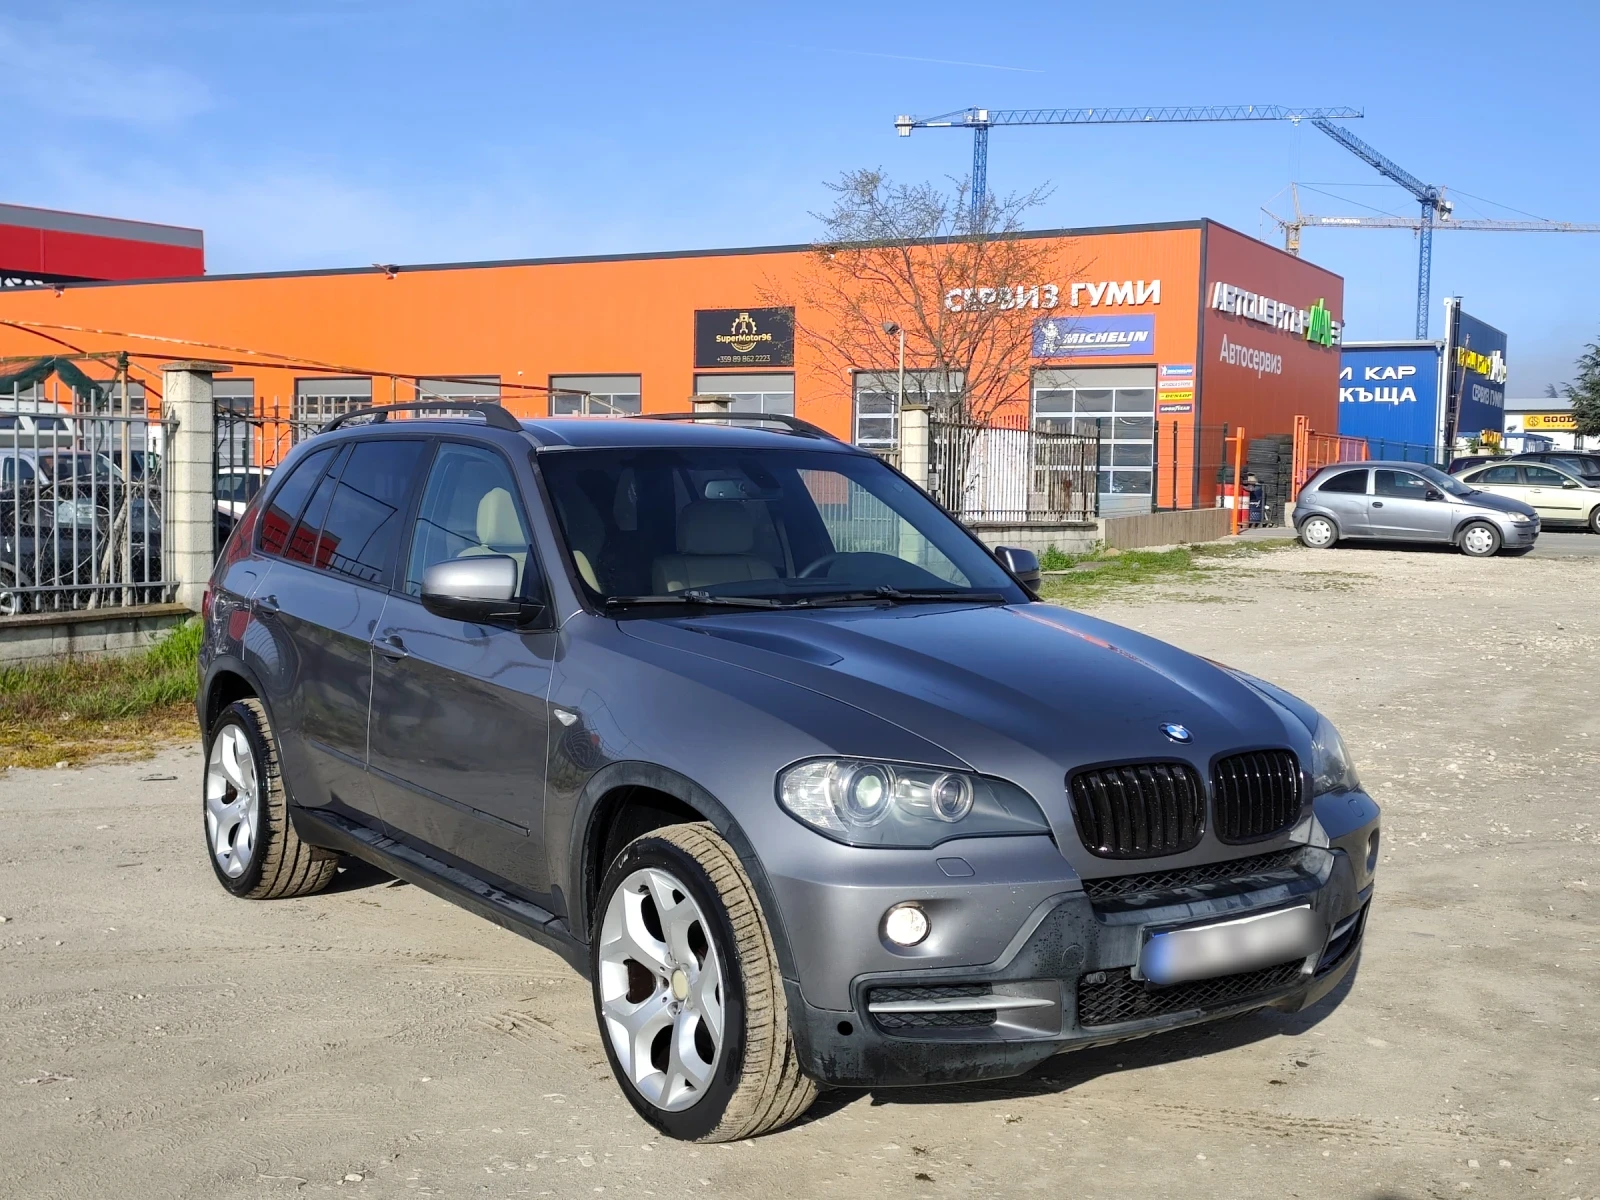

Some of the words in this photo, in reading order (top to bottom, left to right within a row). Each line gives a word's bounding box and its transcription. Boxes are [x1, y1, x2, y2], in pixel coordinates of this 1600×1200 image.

[1070, 280, 1161, 307] ГУМИ
[716, 333, 772, 344] SuperMotor96
[1063, 331, 1149, 344] MICHELIN
[717, 355, 731, 363] +359
[732, 355, 741, 363] 89
[742, 355, 754, 363] 862
[755, 354, 771, 362] 2223
[1365, 366, 1416, 380] КАР
